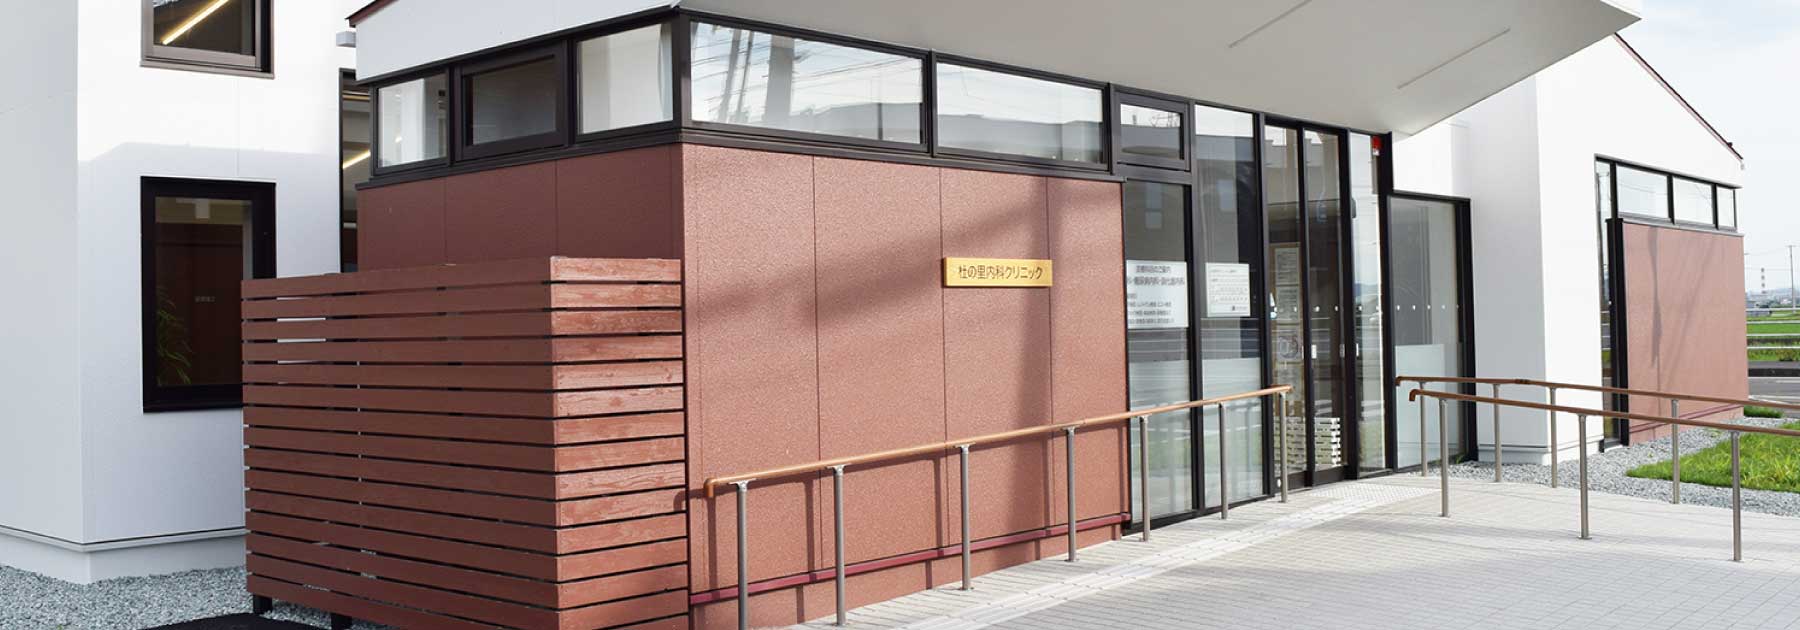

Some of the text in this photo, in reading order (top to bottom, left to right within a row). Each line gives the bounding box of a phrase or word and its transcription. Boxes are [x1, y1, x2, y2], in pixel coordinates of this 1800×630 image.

[959, 264, 1043, 279] 杜の里内科クリニック
